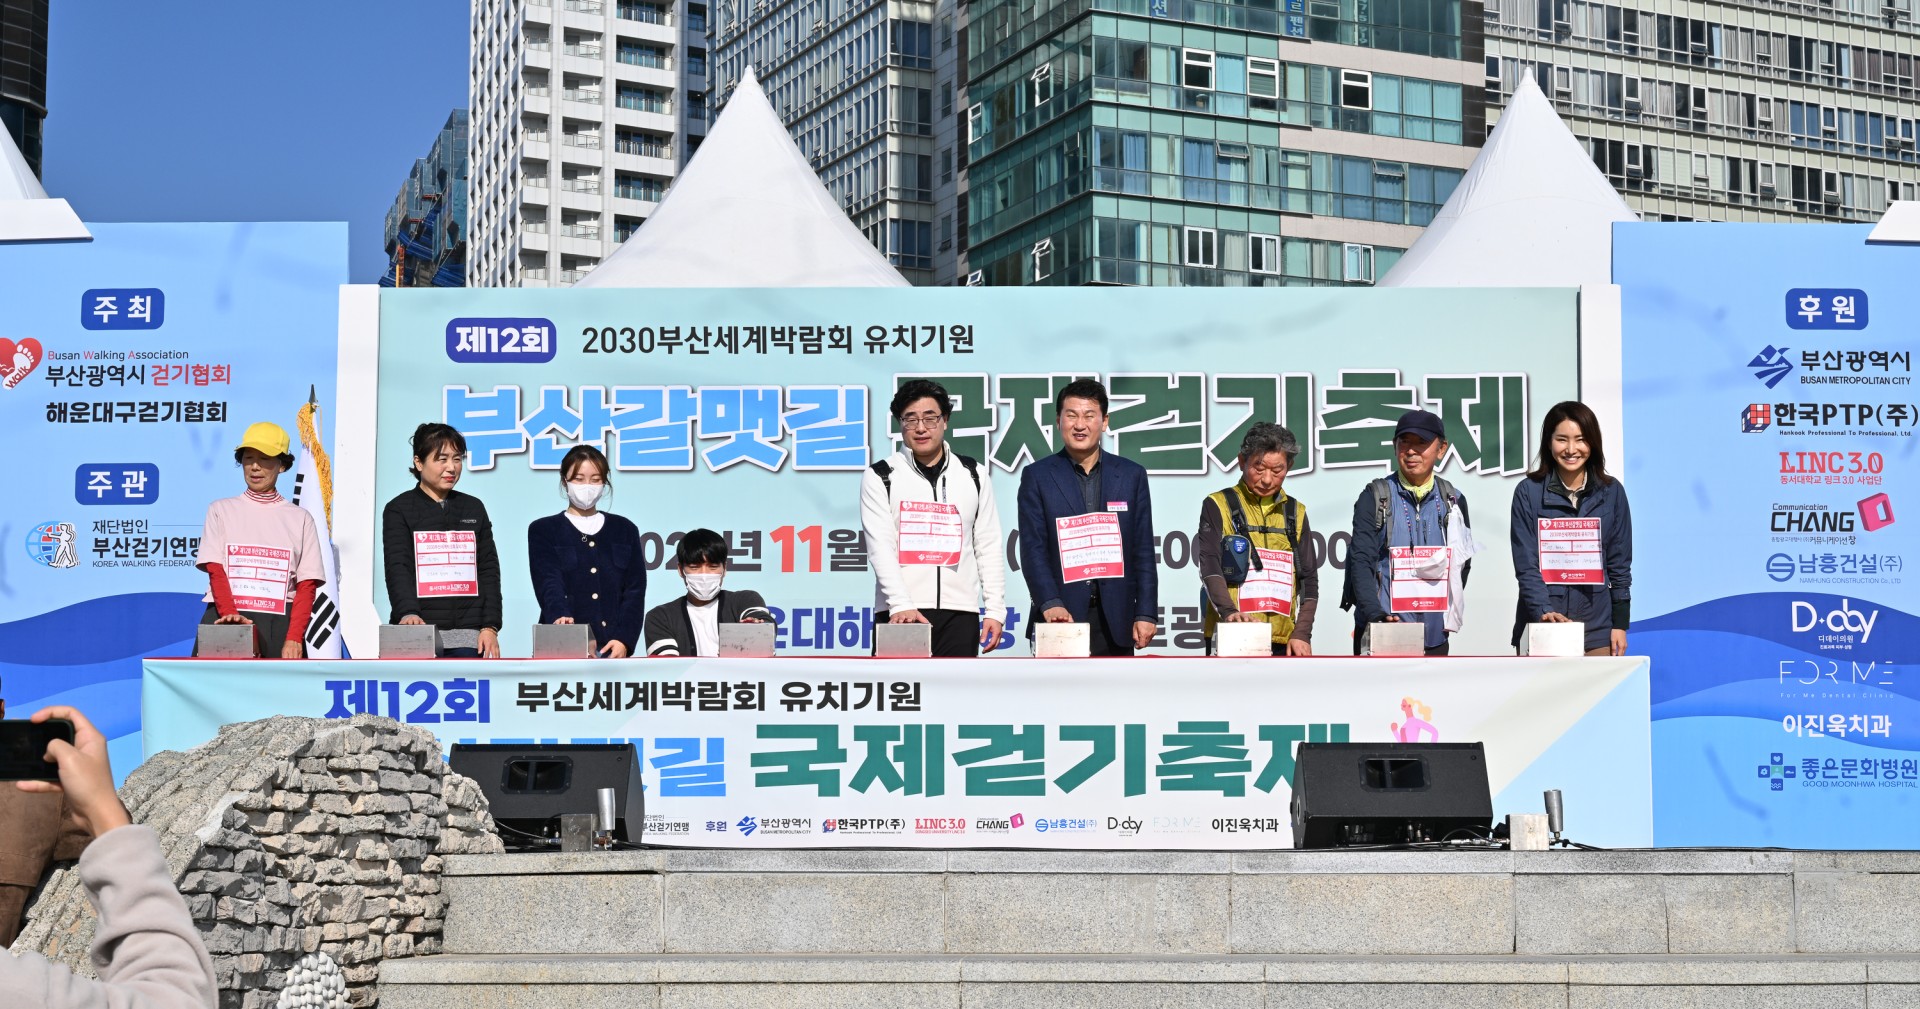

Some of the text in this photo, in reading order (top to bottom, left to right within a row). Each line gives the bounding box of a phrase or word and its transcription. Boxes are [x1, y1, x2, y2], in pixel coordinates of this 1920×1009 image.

[455, 326, 550, 354] 제12회
[582, 324, 975, 355] 2030부산세계박람회 유치기원
[48, 350, 189, 361] Busan Walking Association
[1801, 350, 1911, 373] 부산광역시
[45, 364, 231, 387] 부산광역시 걷기협회
[1800, 376, 1911, 385] BUSAN METROPOLITAN CITY
[46, 401, 227, 423] 해운대구걷기협회
[1774, 403, 1919, 428] 한국PTP(주)
[442, 384, 871, 473] 부산갈맷길
[1779, 451, 1884, 474] LINC 3.0
[1780, 475, 1882, 486] 동서대학교 링크 3.0 사업단
[1772, 503, 1828, 511] Communication
[92, 519, 148, 534] 재단법인
[1770, 511, 1855, 533] CHANG
[92, 560, 118, 568] KOREA
[1780, 660, 1894, 685] FOR ME
[324, 677, 922, 724] 제12회 부산세계박람회 유치기원
[1782, 714, 1892, 738] 이진욱치과
[1802, 757, 1919, 780] 좋은문화병원
[1802, 780, 1919, 788] GOOD MOONHWA HOSPITAL
[705, 820, 727, 832] 후원
[761, 818, 812, 829] 부산광역시
[838, 818, 906, 830] 한국PTP(주)
[915, 818, 966, 830] LINC 3.0
[976, 820, 1010, 830] CHANG
[1211, 818, 1280, 833] 이진욱치과
